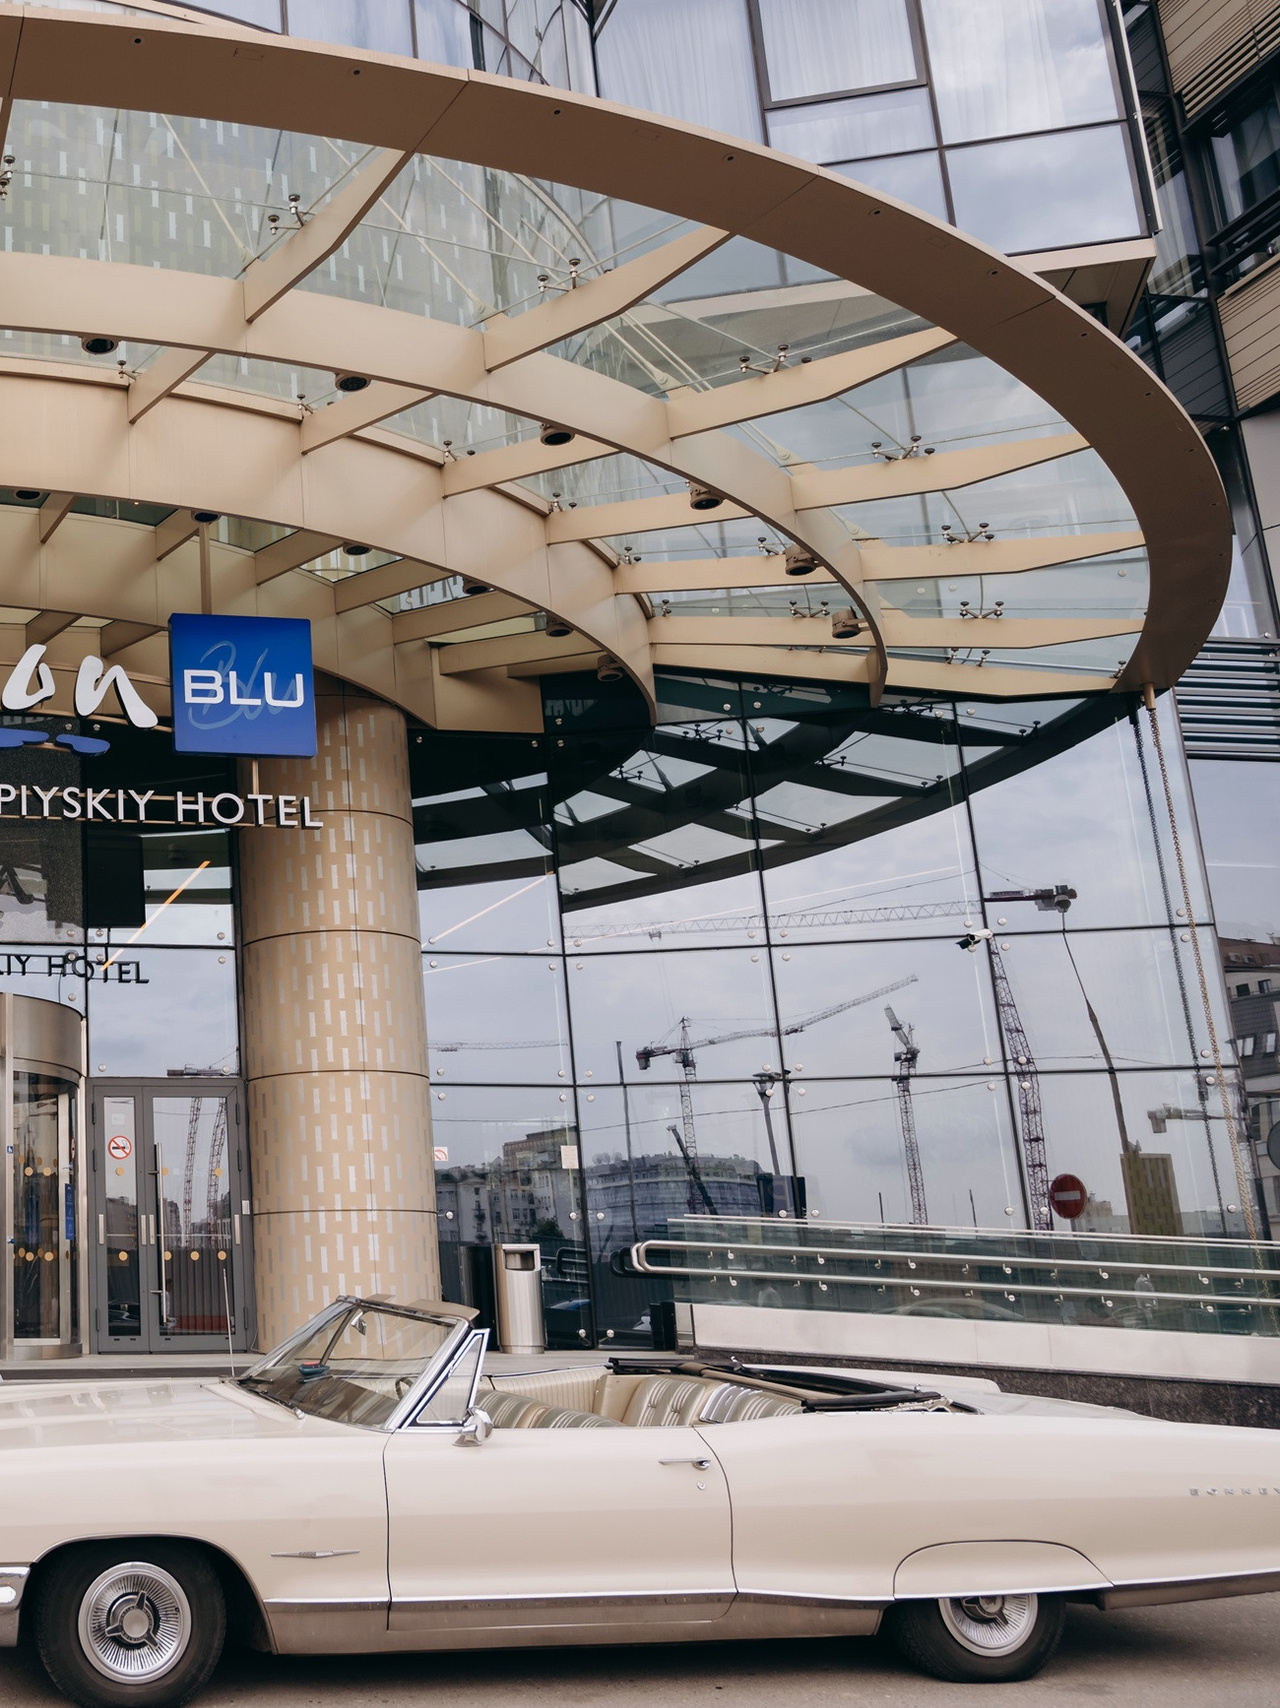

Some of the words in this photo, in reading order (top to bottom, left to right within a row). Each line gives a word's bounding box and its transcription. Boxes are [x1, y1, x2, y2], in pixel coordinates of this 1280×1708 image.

[184, 669, 305, 708] BLU
[176, 790, 324, 829] HOTEL
[48, 954, 150, 984] HOTEL
